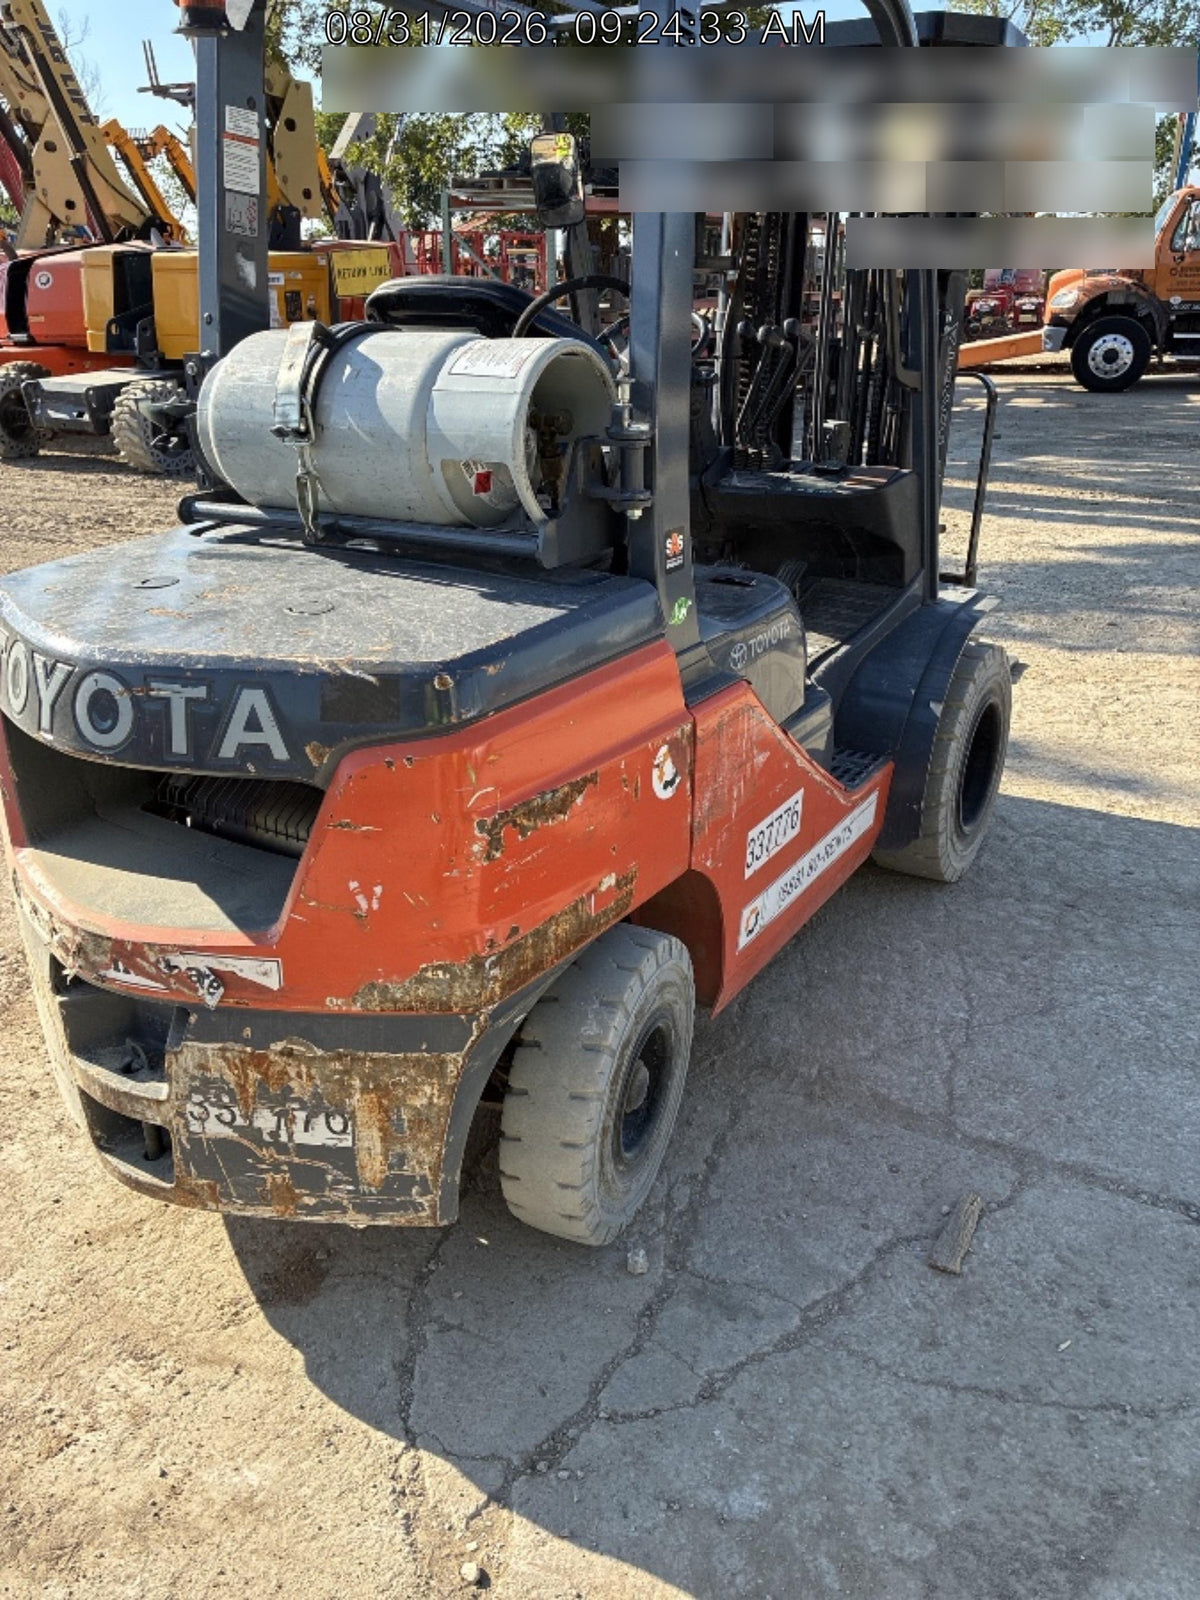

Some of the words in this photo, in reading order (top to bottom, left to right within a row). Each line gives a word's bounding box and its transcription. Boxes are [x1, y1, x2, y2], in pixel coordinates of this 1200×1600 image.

[35, 18, 67, 63] JLG
[748, 618, 790, 657] TOYOTA
[746, 800, 799, 869] 337776
